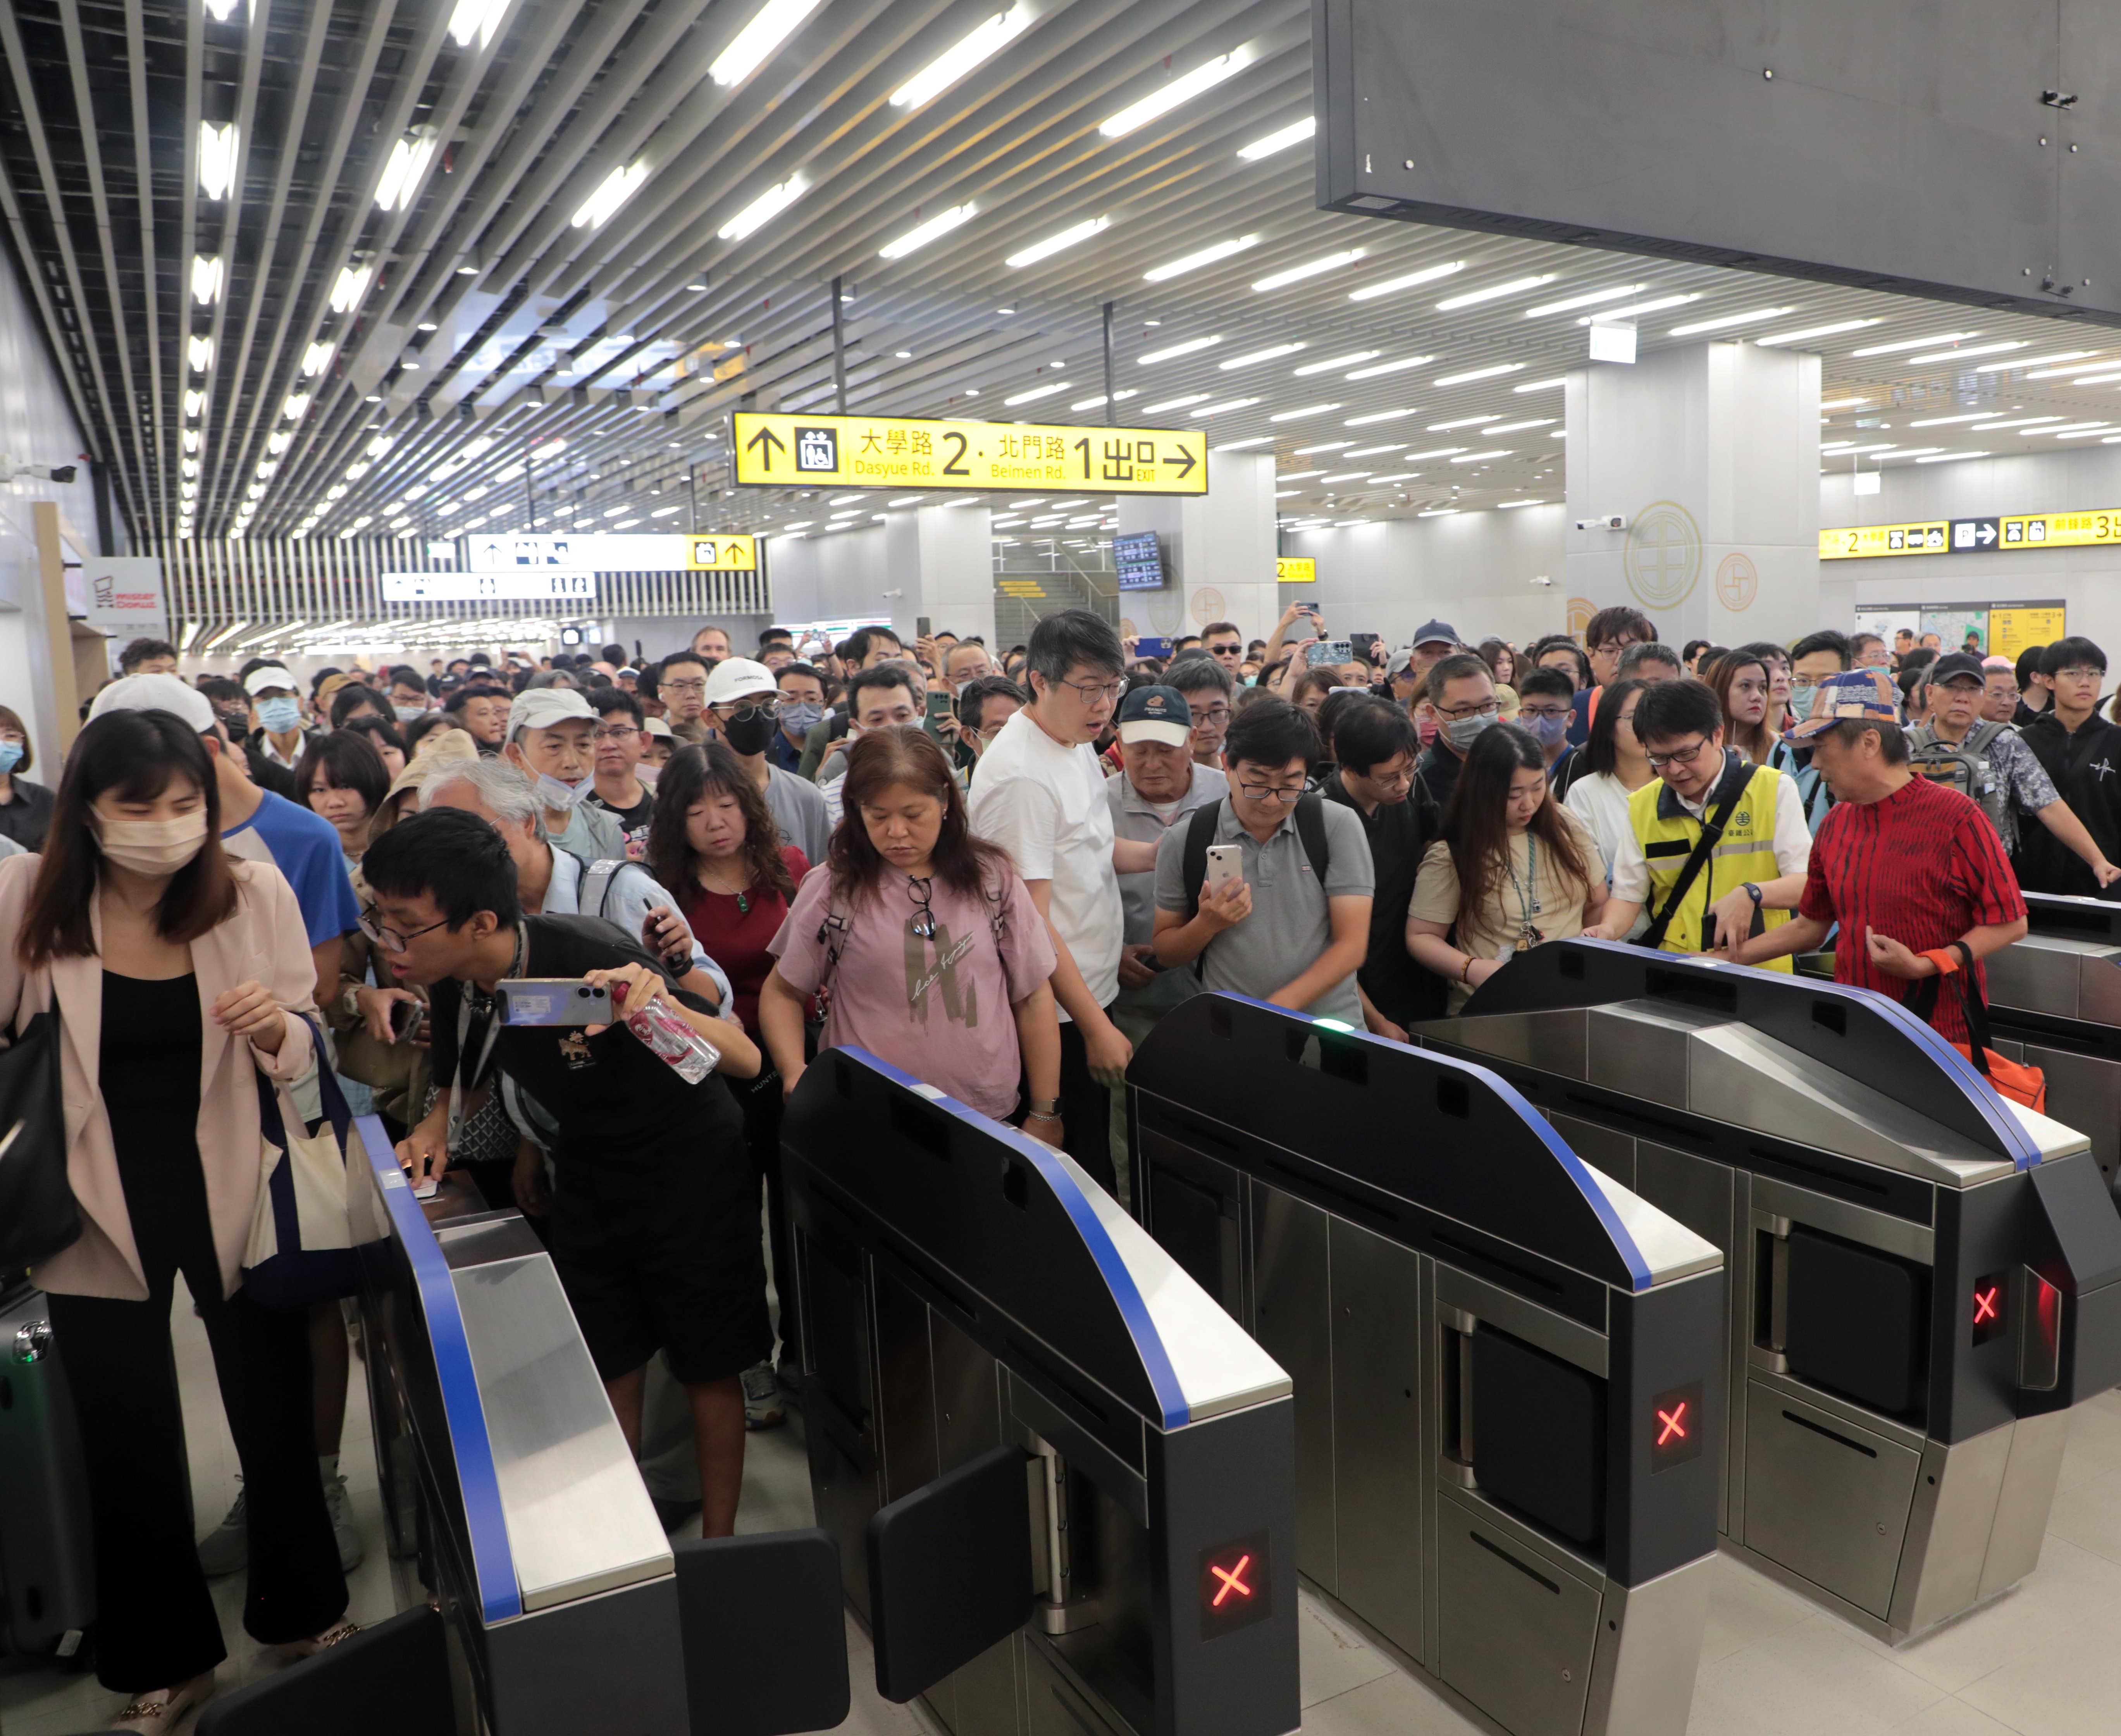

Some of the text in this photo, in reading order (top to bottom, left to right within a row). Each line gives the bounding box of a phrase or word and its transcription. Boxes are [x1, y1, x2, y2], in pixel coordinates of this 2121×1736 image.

[861, 428, 970, 476] 大學路 2
[999, 434, 1155, 481] 北門路 1 出口
[855, 460, 935, 479] Dasyue Rd.
[991, 464, 1066, 480] Beimen Rd.
[1136, 469, 1155, 482] EXIT
[2096, 516, 2109, 538] 3
[1848, 533, 1858, 552] 2
[1276, 562, 1285, 577] 2
